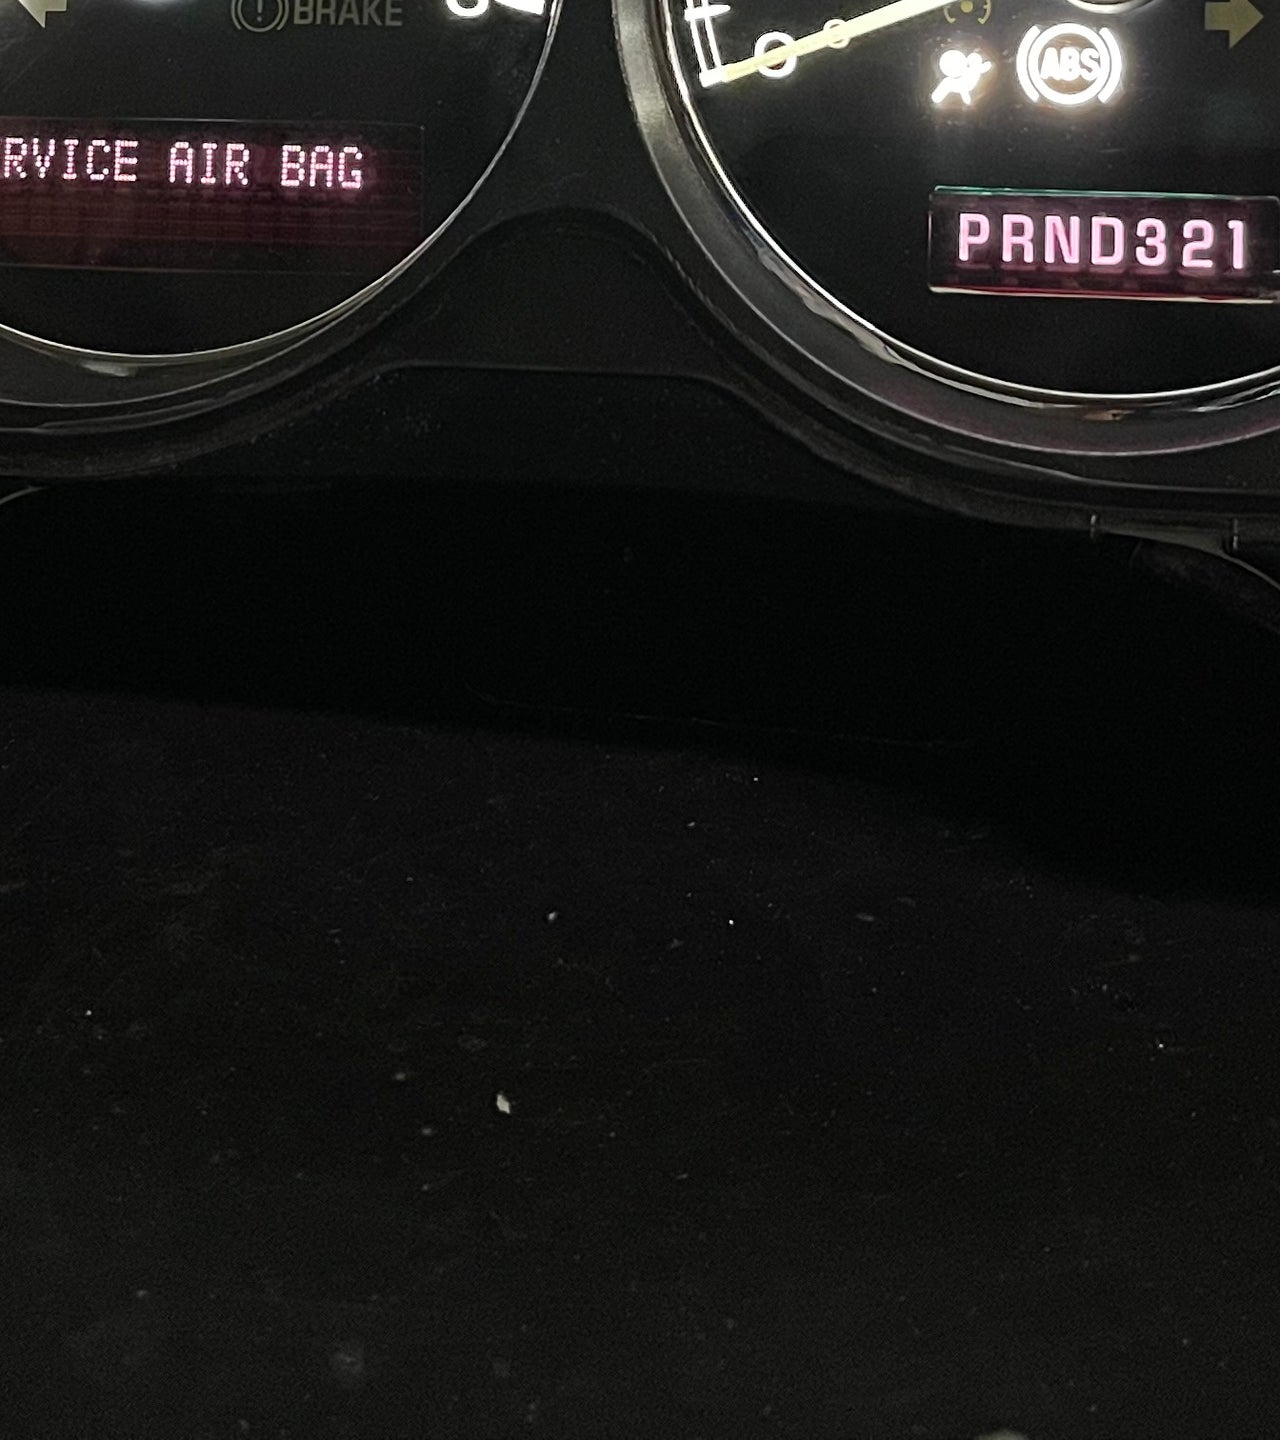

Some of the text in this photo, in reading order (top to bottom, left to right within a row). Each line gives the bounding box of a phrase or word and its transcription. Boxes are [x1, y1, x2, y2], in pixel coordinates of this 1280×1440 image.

[754, 31, 797, 78] 0
[1040, 46, 1100, 81] ABS
[170, 142, 249, 185] AIR
[281, 145, 362, 189] BAG
